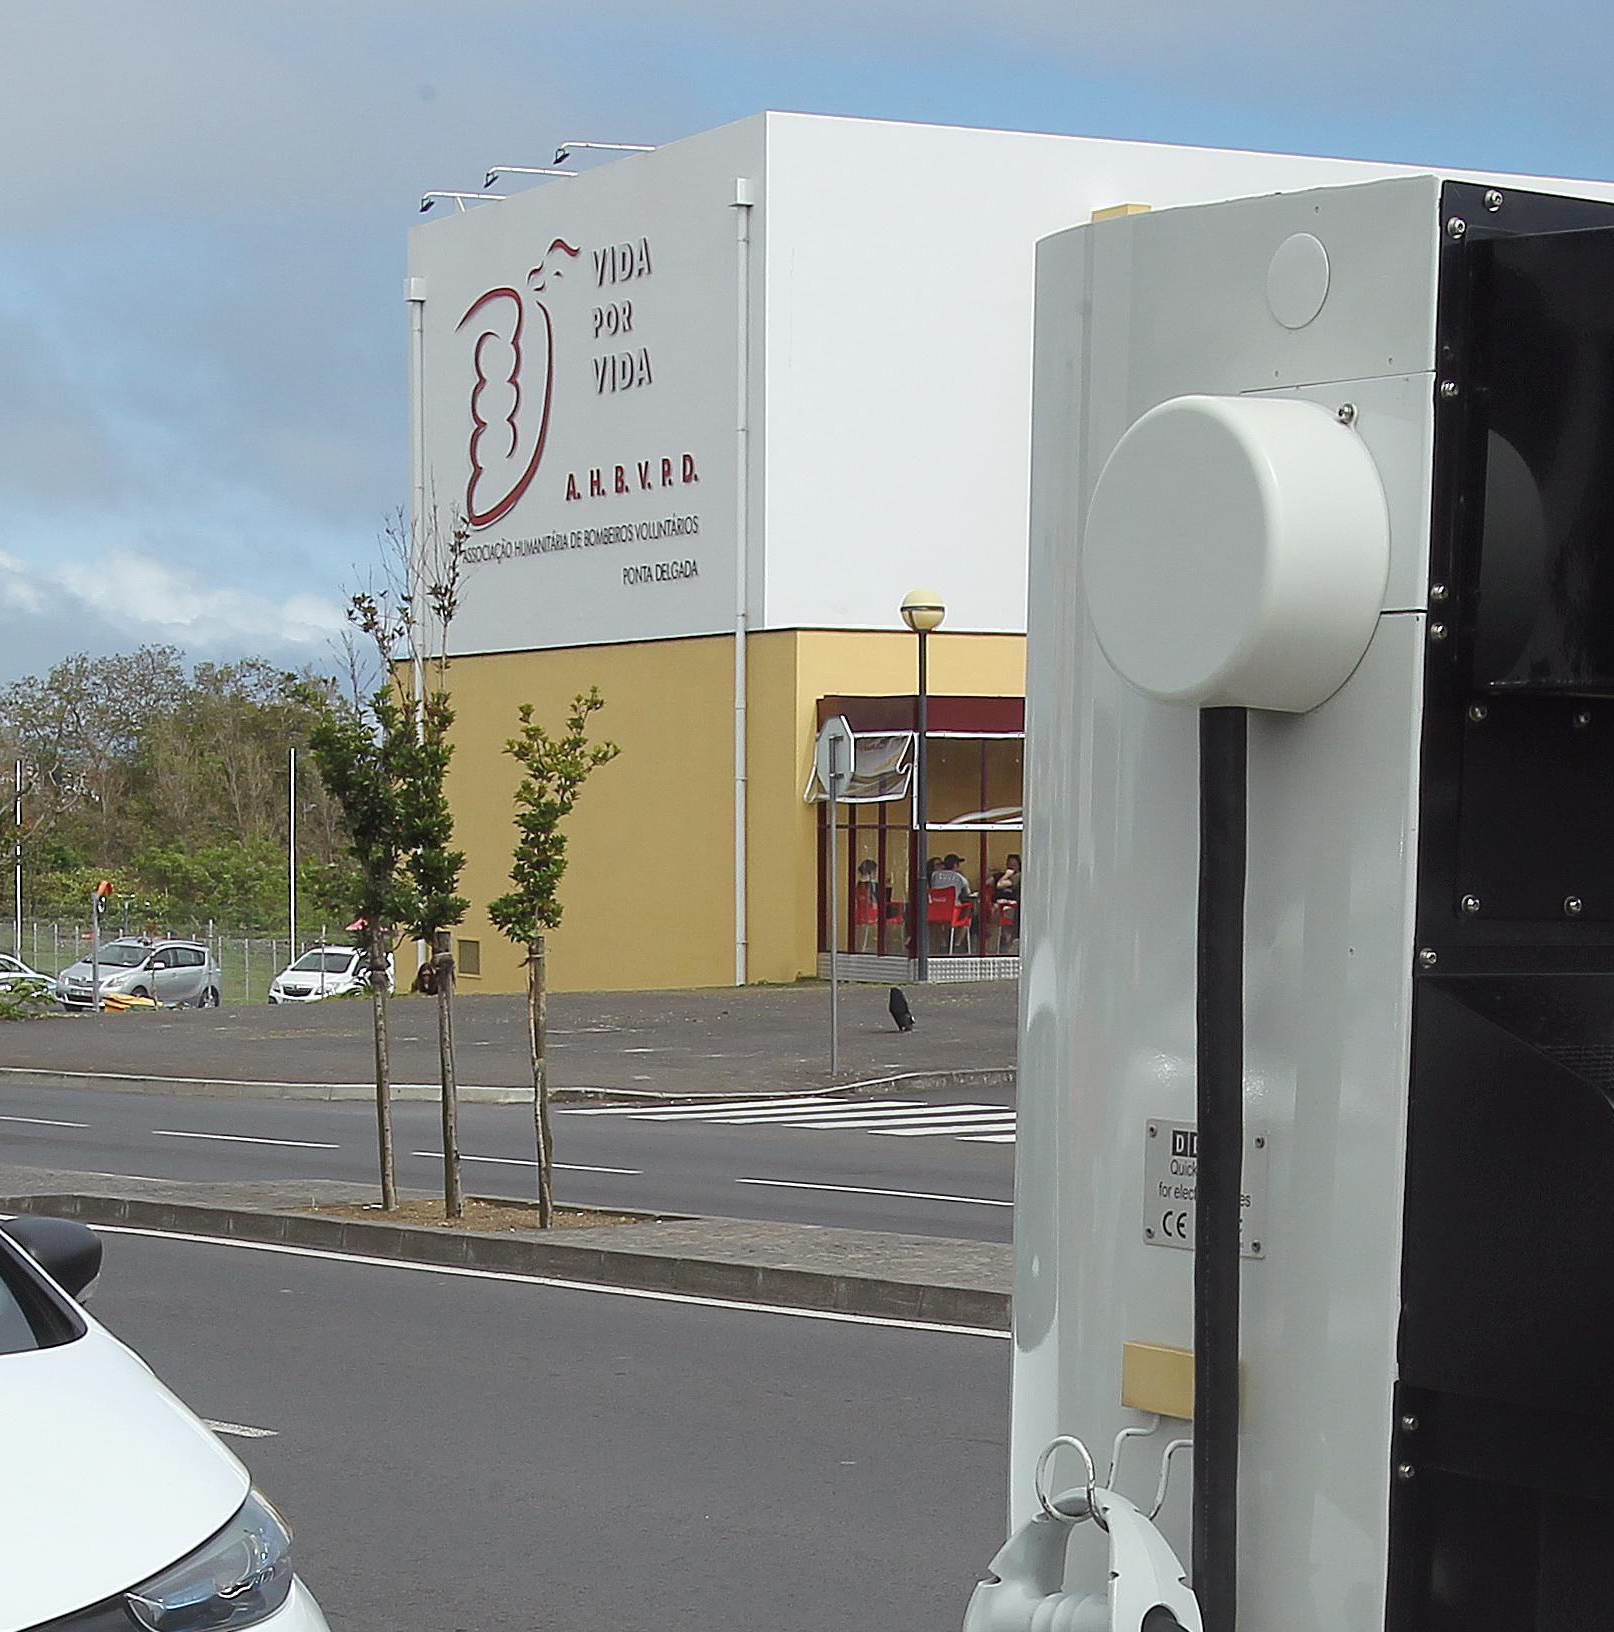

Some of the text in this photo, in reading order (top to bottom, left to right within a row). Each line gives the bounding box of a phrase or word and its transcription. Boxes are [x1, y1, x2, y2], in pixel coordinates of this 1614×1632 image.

[592, 237, 652, 288] VIDA
[591, 300, 633, 339] POR
[592, 347, 653, 395] VIDA
[570, 530, 583, 548] DE
[584, 523, 633, 546] BOMBEIROS
[634, 512, 699, 540] VOLUNTÁRIOS
[622, 560, 699, 585] PONTA DELGADA
[1159, 1181, 1172, 1198] for
